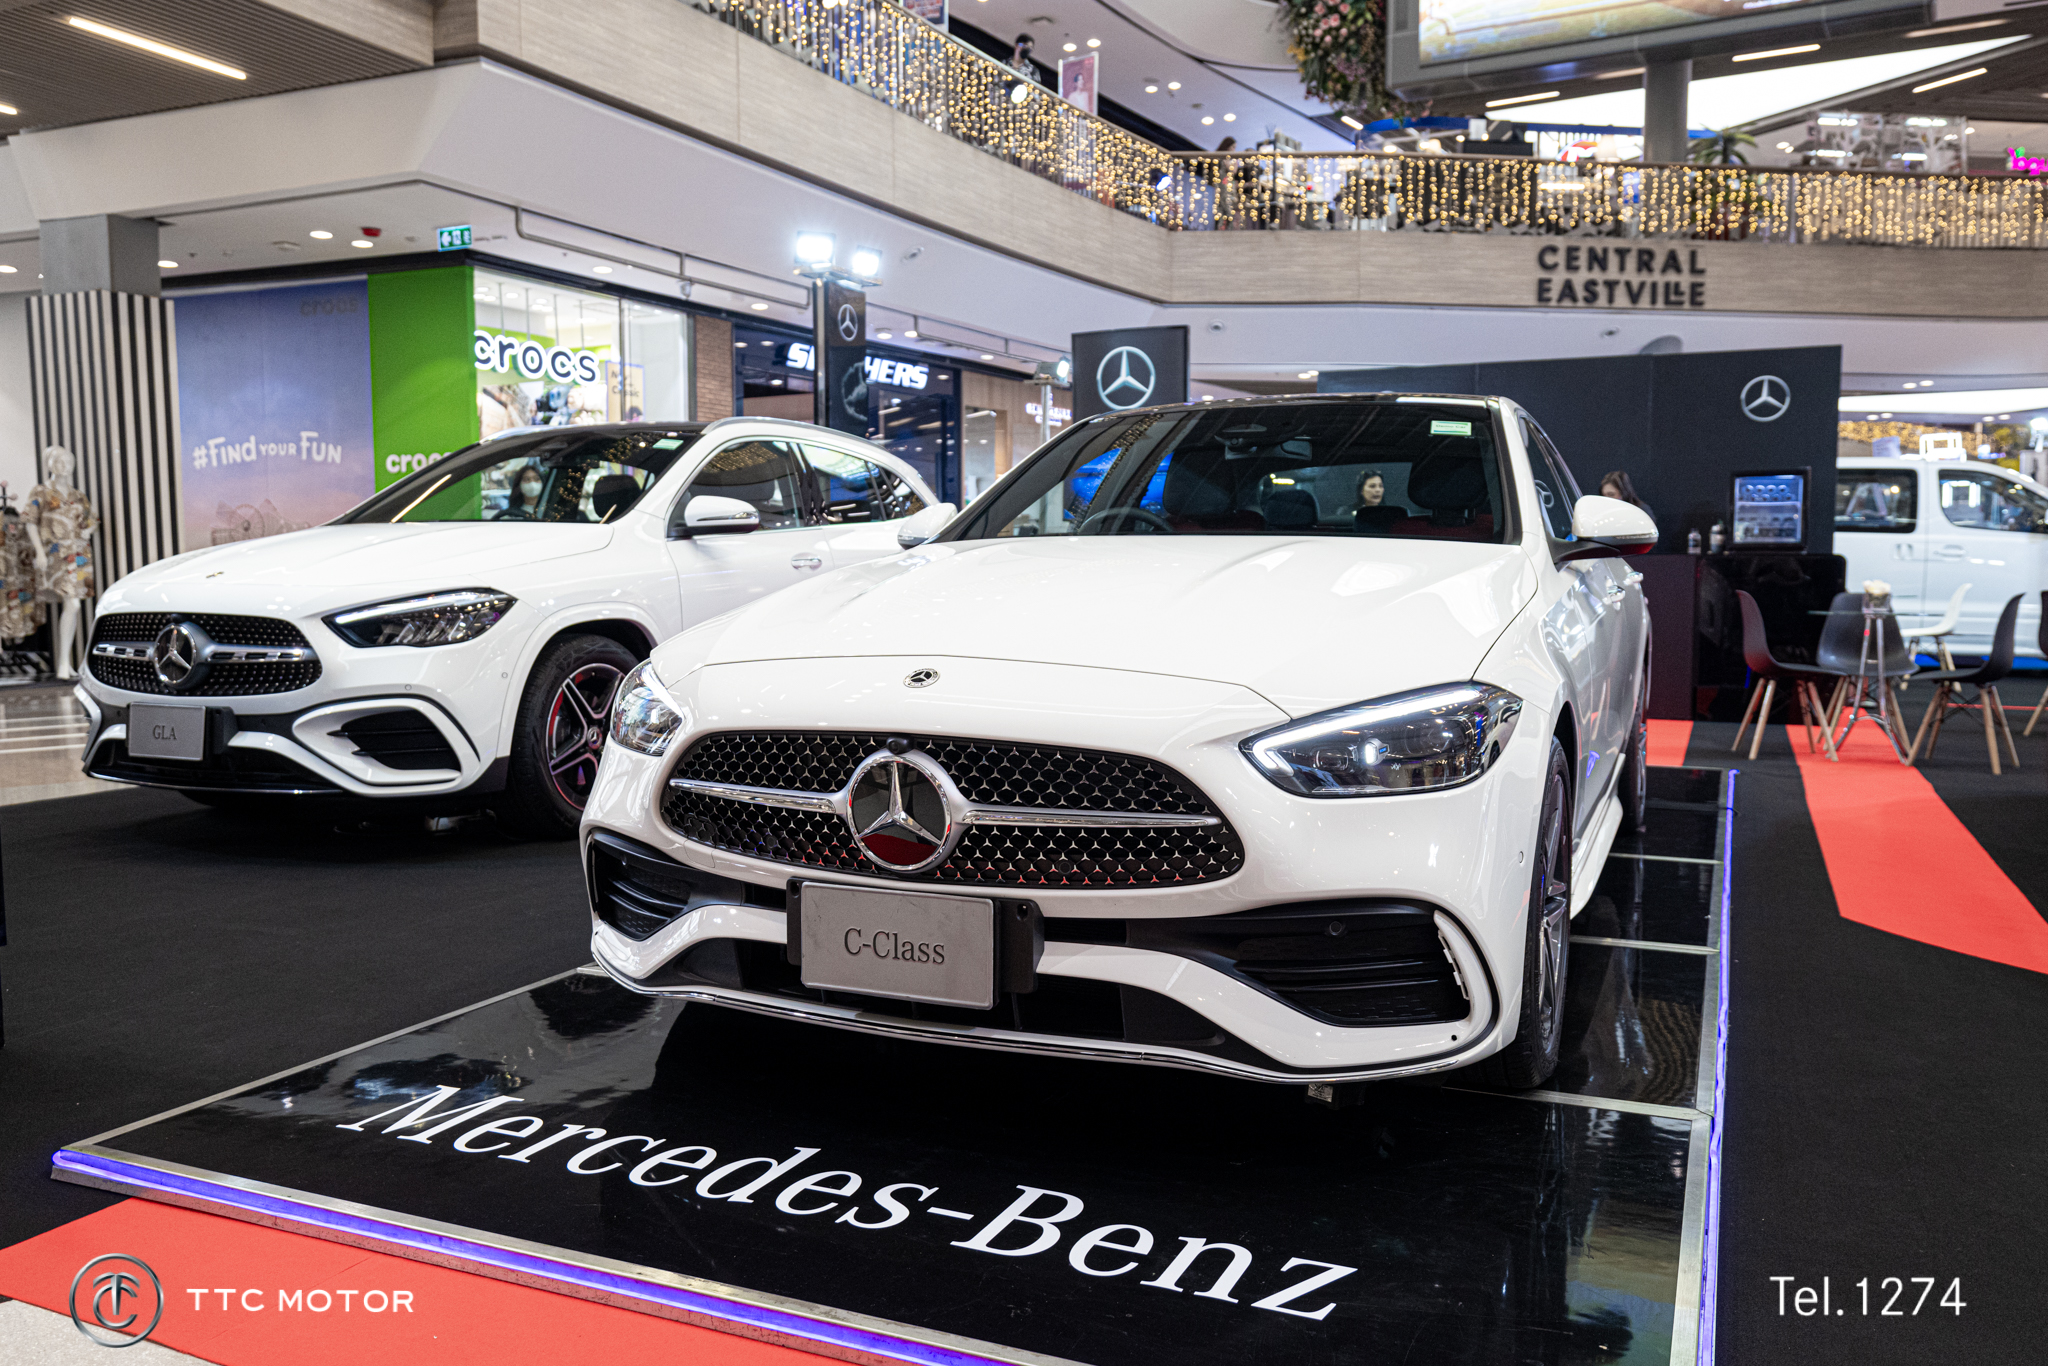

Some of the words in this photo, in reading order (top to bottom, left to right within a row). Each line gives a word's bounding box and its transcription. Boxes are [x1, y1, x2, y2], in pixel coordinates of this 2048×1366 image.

[1537, 244, 1707, 275] CENTRAL
[1537, 277, 1706, 307] EASTVILLE
[474, 331, 599, 385] crocs
[300, 431, 342, 463] FUN
[153, 725, 177, 740] GLA
[844, 928, 945, 965] C-Class
[336, 1084, 1358, 1321] Mercedes-Benz
